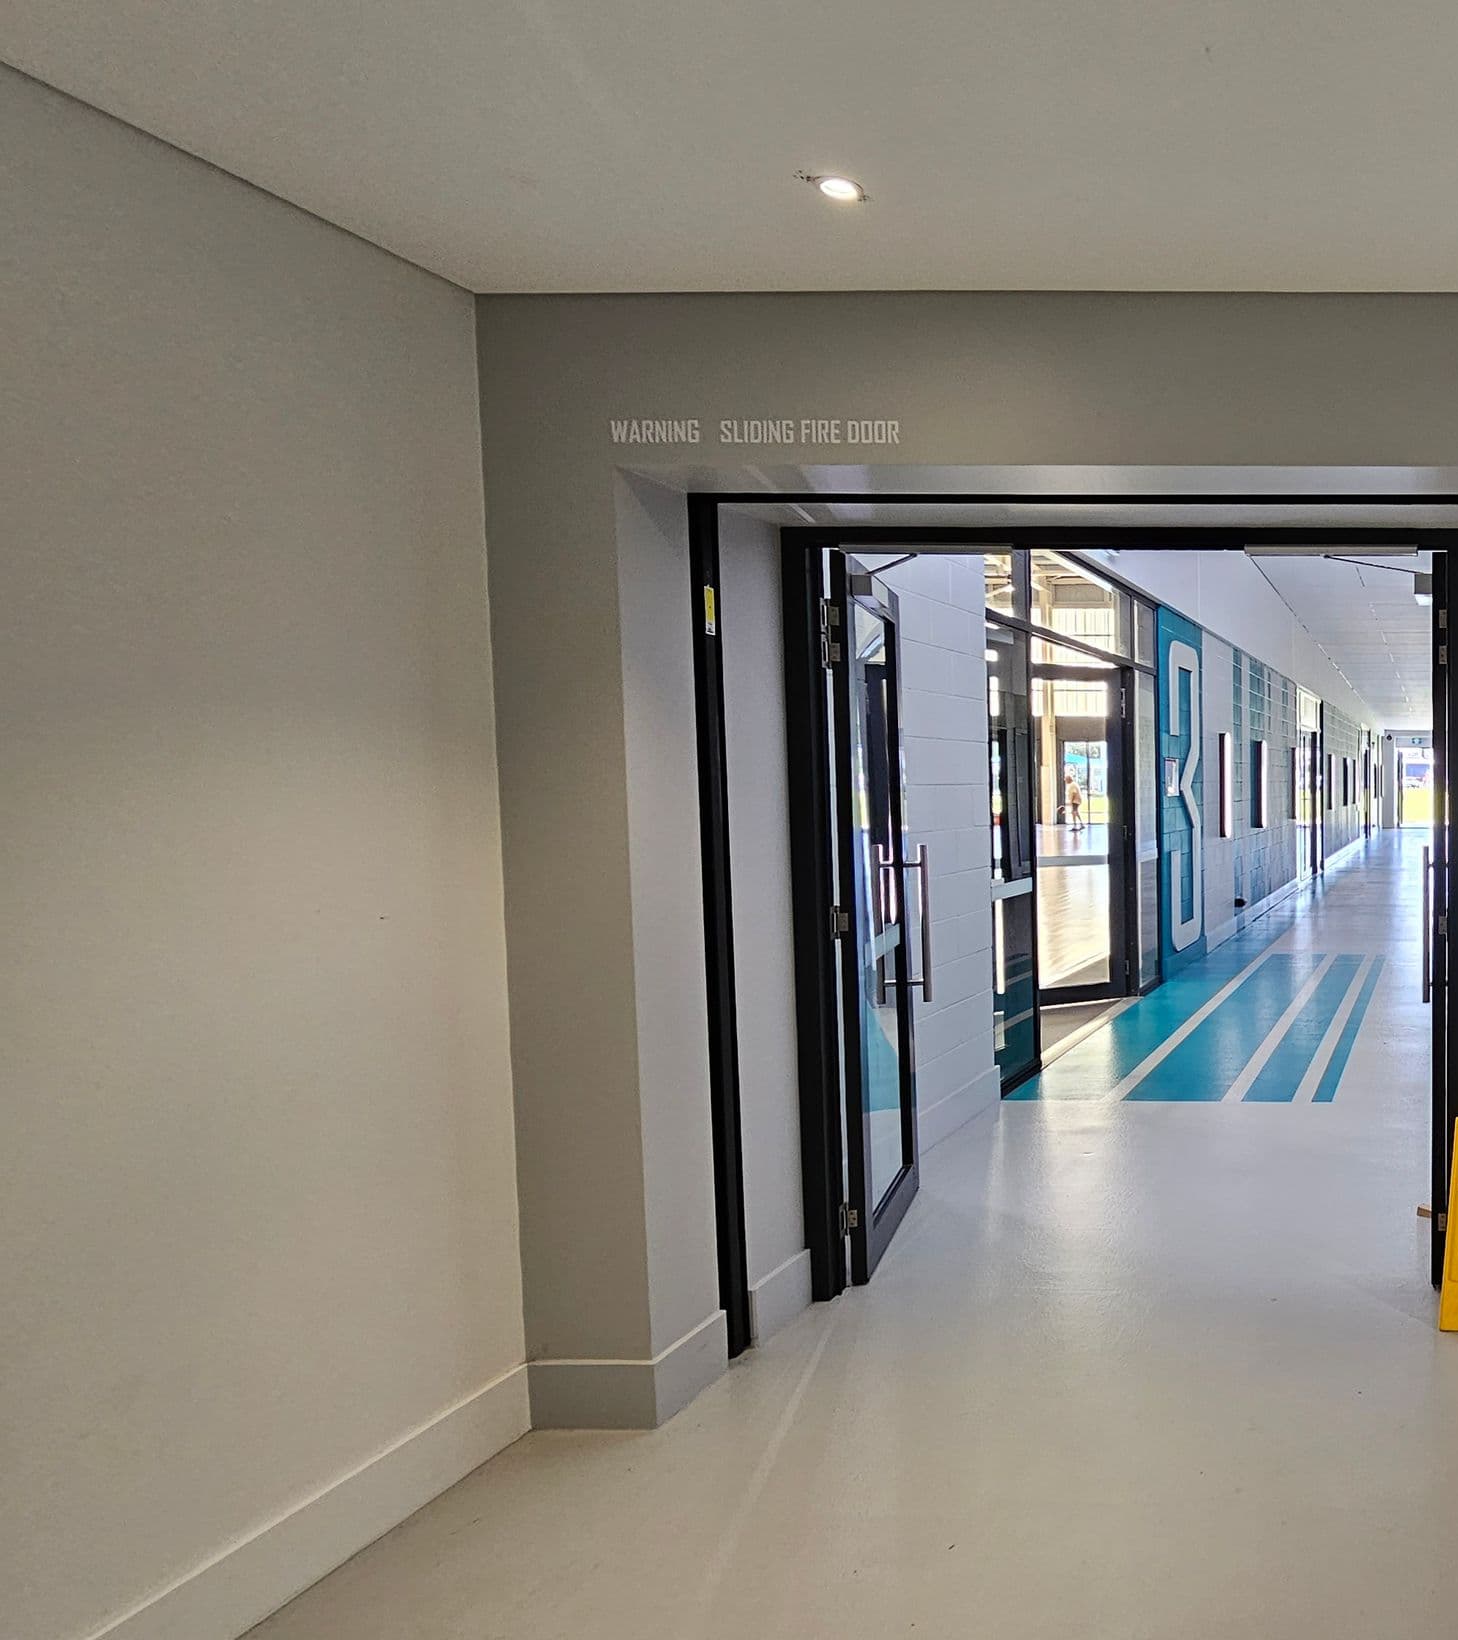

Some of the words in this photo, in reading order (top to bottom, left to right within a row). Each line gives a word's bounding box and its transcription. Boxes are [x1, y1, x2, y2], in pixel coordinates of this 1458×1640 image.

[611, 419, 700, 444] WARNING
[720, 420, 794, 443] SLIDING
[801, 420, 841, 443] FIRE
[847, 420, 899, 443] DOOR
[1169, 640, 1202, 952] 3
